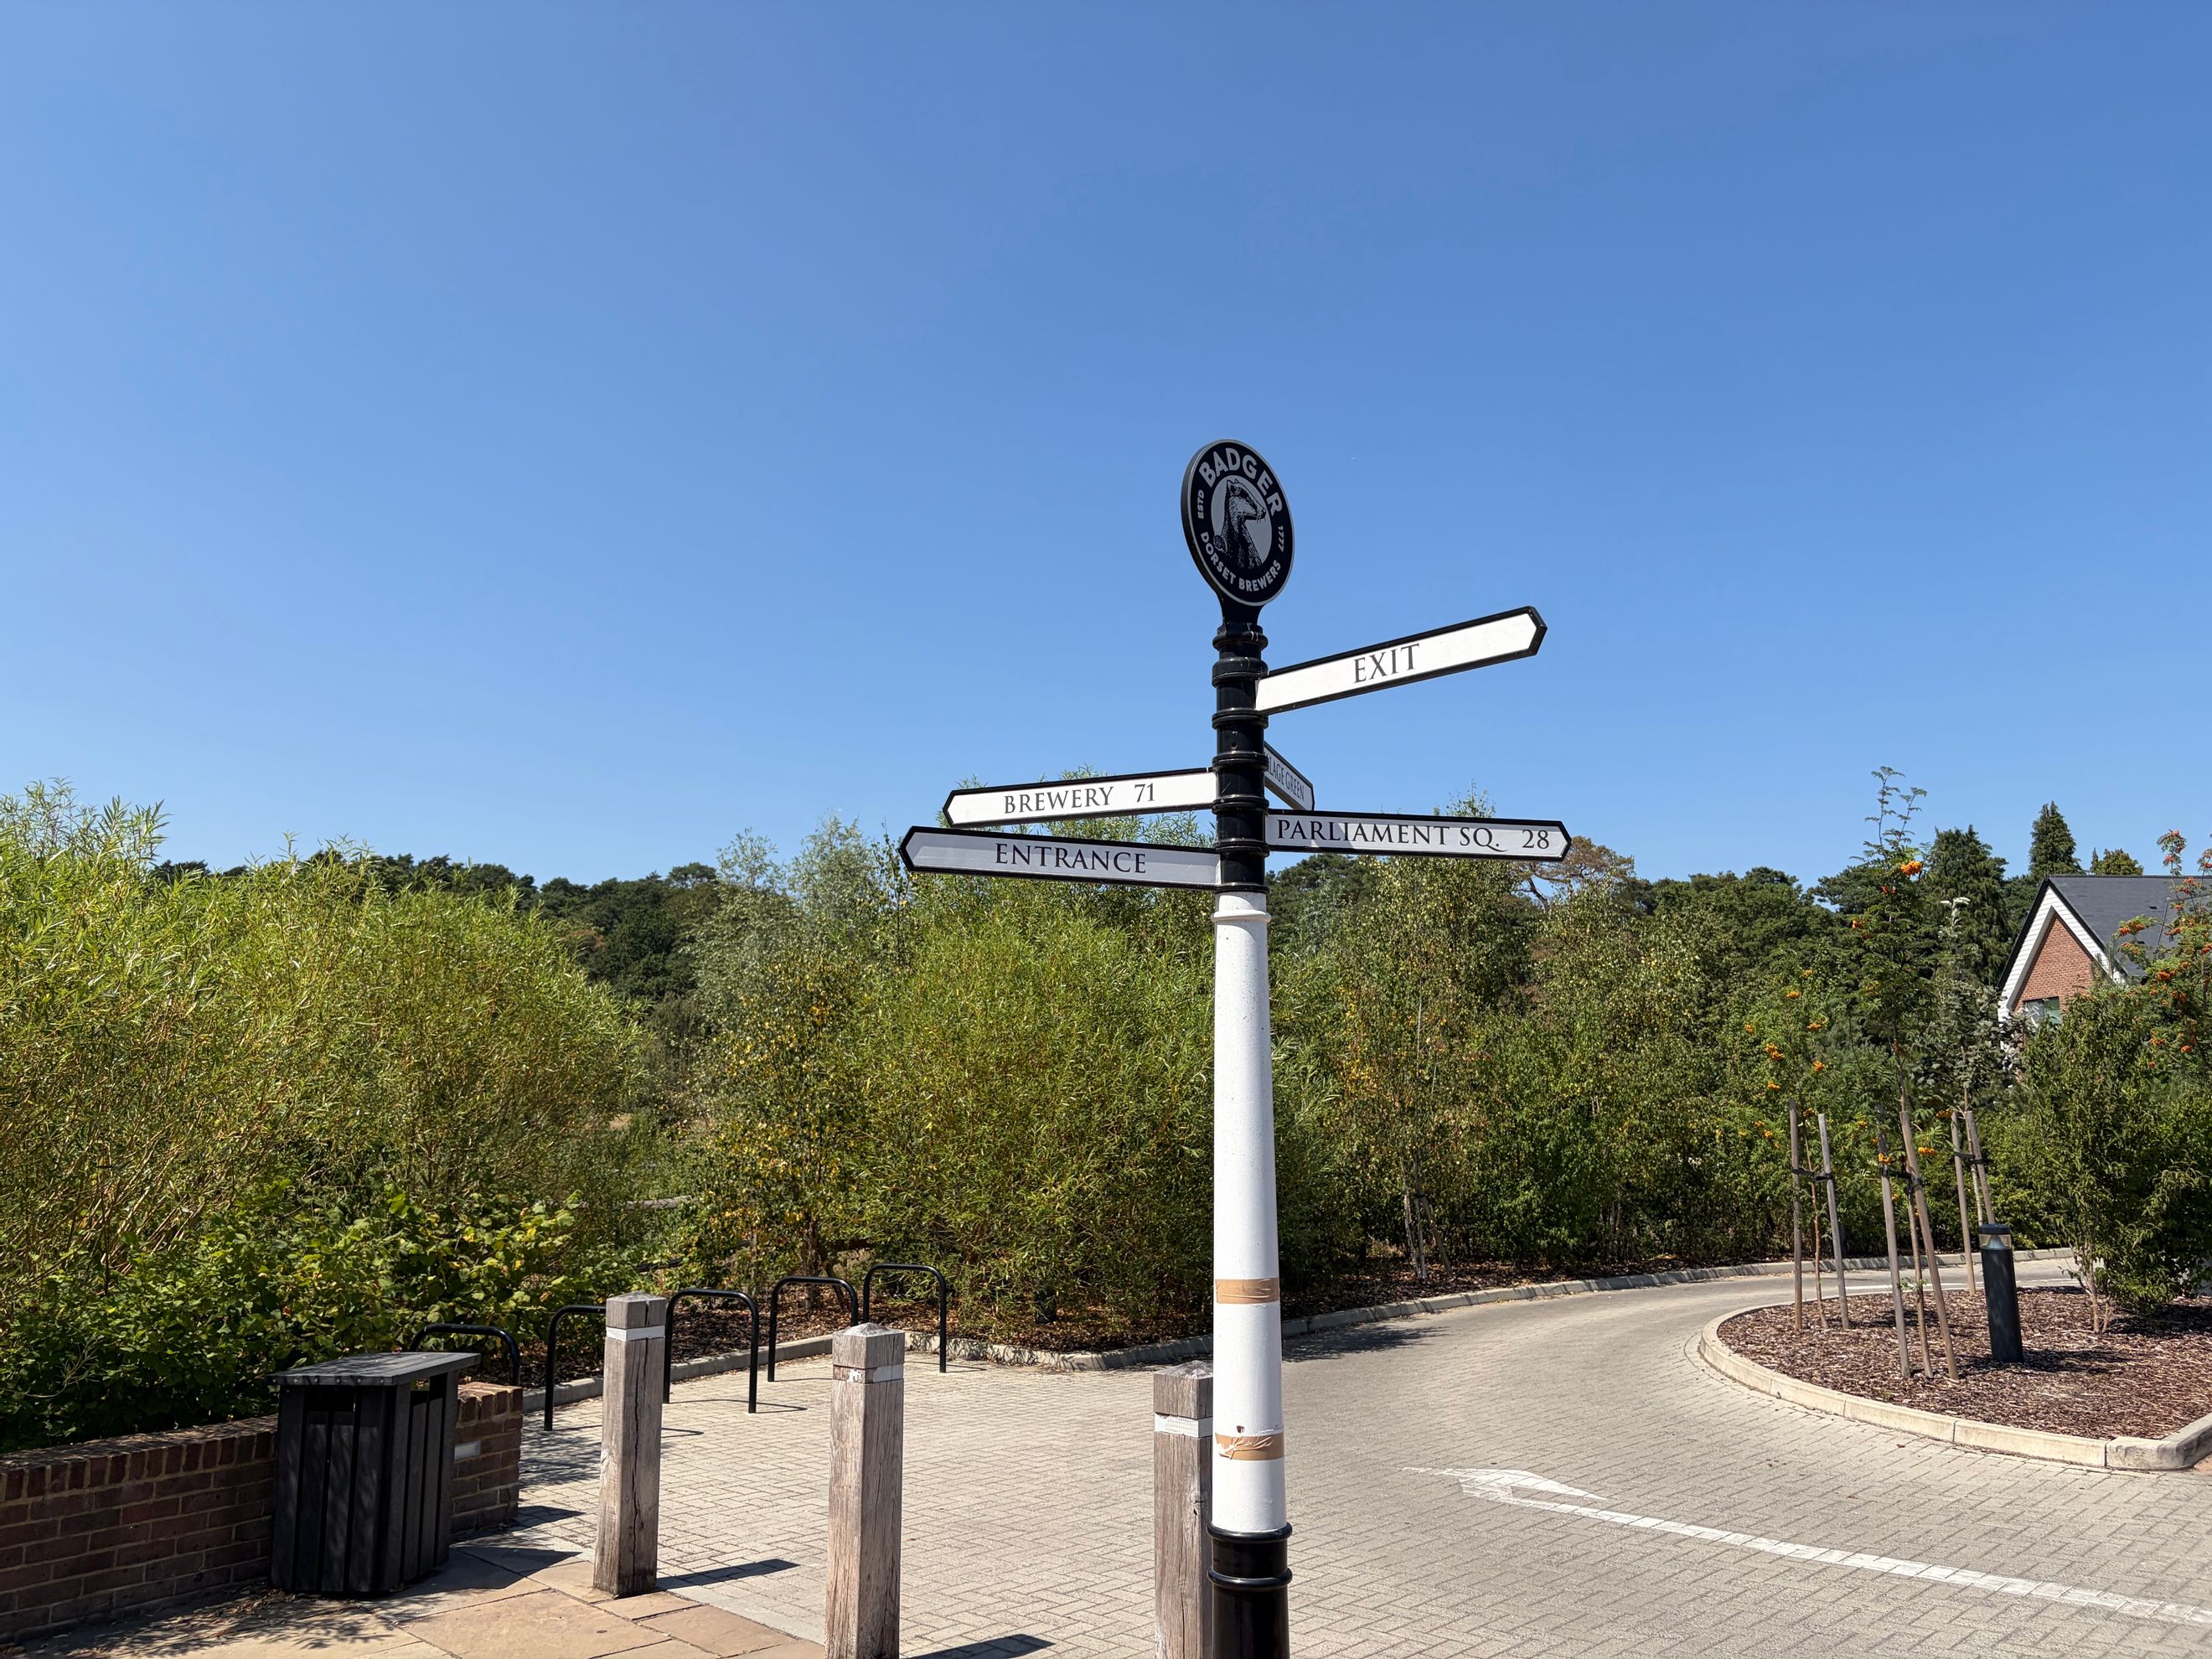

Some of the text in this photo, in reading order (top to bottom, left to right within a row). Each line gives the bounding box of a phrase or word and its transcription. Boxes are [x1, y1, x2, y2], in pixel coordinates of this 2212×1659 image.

[1199, 448, 1283, 516] BADGER
[1201, 532, 1281, 592] DORSET BREWERS
[1354, 643, 1420, 684] EXIT
[1005, 783, 1155, 814] BREWERY 71
[1286, 773, 1304, 801] GREEN
[1278, 819, 1549, 853] PARLIAMENT SQ. 28
[995, 844, 1145, 874] ENTRANCE
